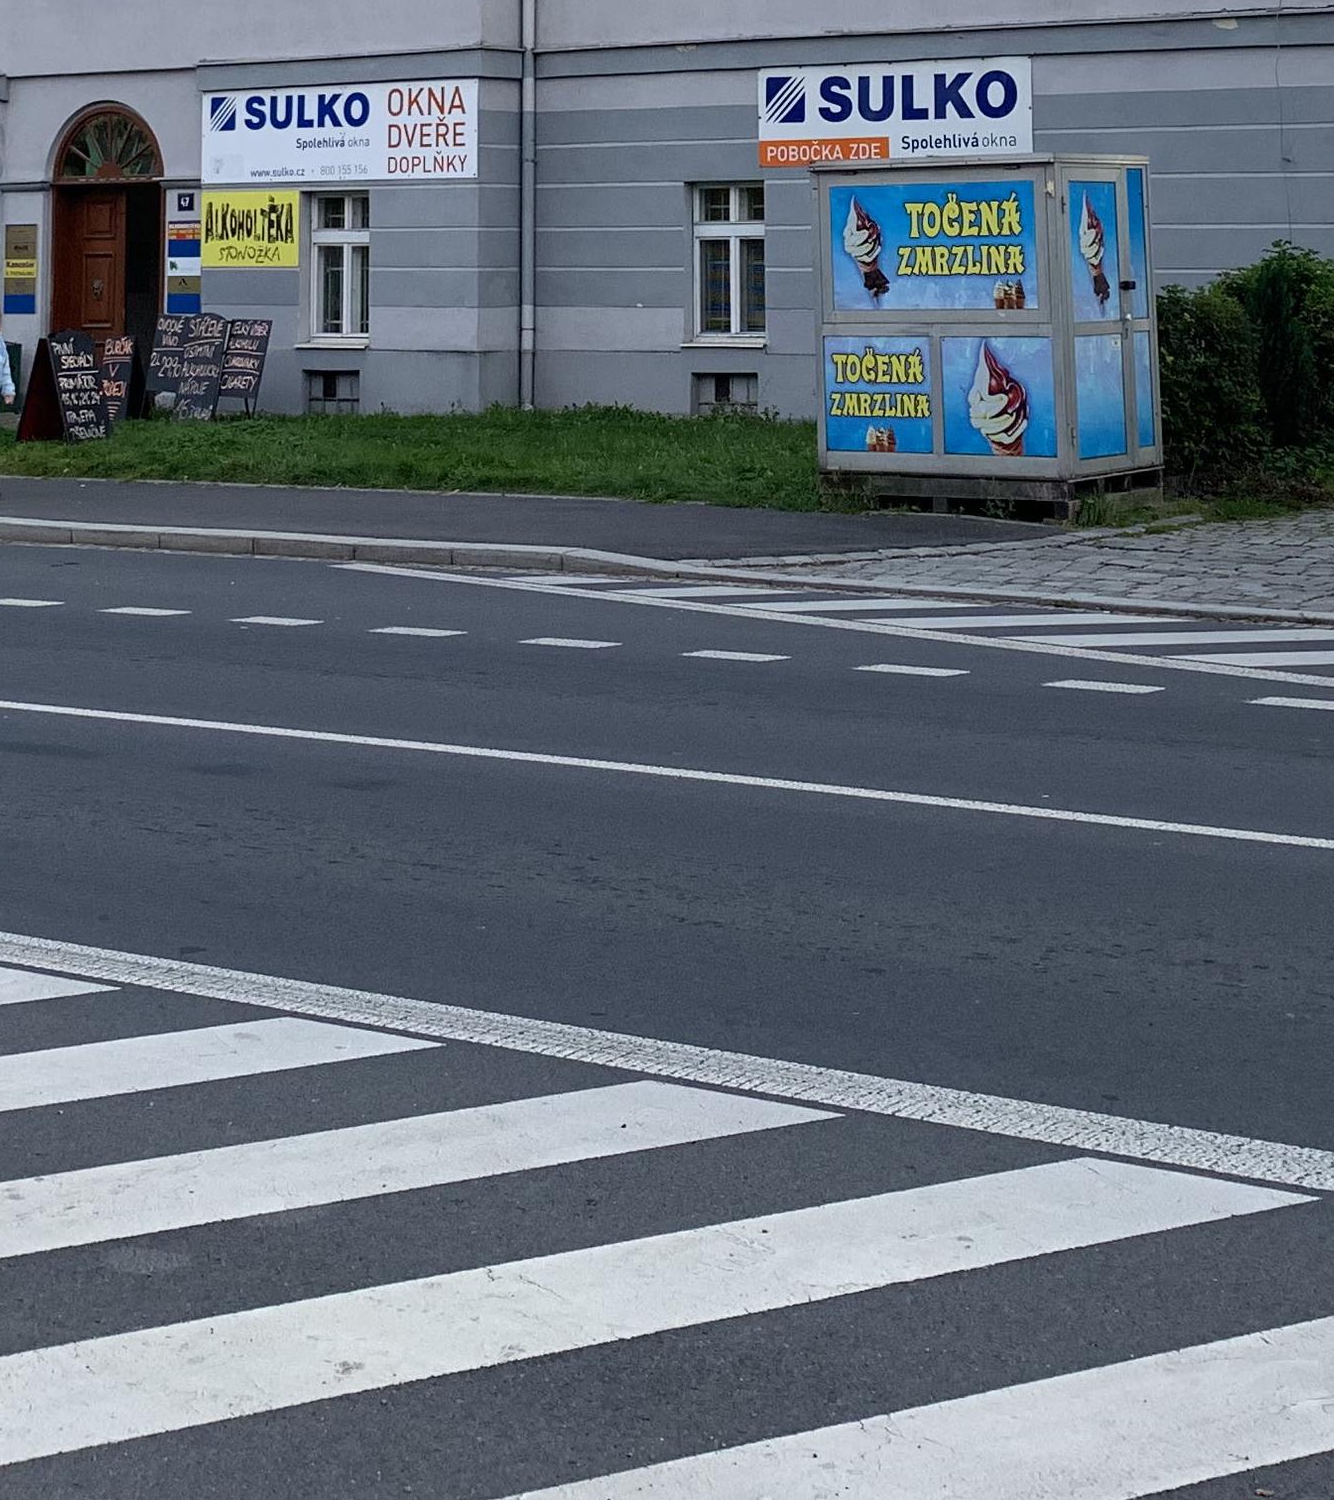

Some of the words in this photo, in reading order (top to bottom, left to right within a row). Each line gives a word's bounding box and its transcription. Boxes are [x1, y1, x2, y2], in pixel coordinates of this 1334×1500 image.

[244, 92, 370, 130] SULKO
[387, 86, 467, 117] OKNA
[818, 70, 1018, 122] SULKO
[296, 135, 345, 150] Spolehlivá
[347, 138, 370, 147] okna
[387, 116, 466, 148] DVEŘE
[901, 132, 979, 153] Spolehlivá
[982, 134, 1017, 148] okna
[387, 151, 468, 174] DOPLŇKY
[767, 141, 844, 162] POBOČKA
[849, 143, 881, 159] ZDE
[250, 168, 305, 177] www.sulko.cz
[904, 192, 1022, 238] TOČENÁ
[897, 245, 1026, 276] ZMRZLINA
[832, 348, 924, 384] TOČENÁ
[830, 393, 931, 418] ZMRZLINA
